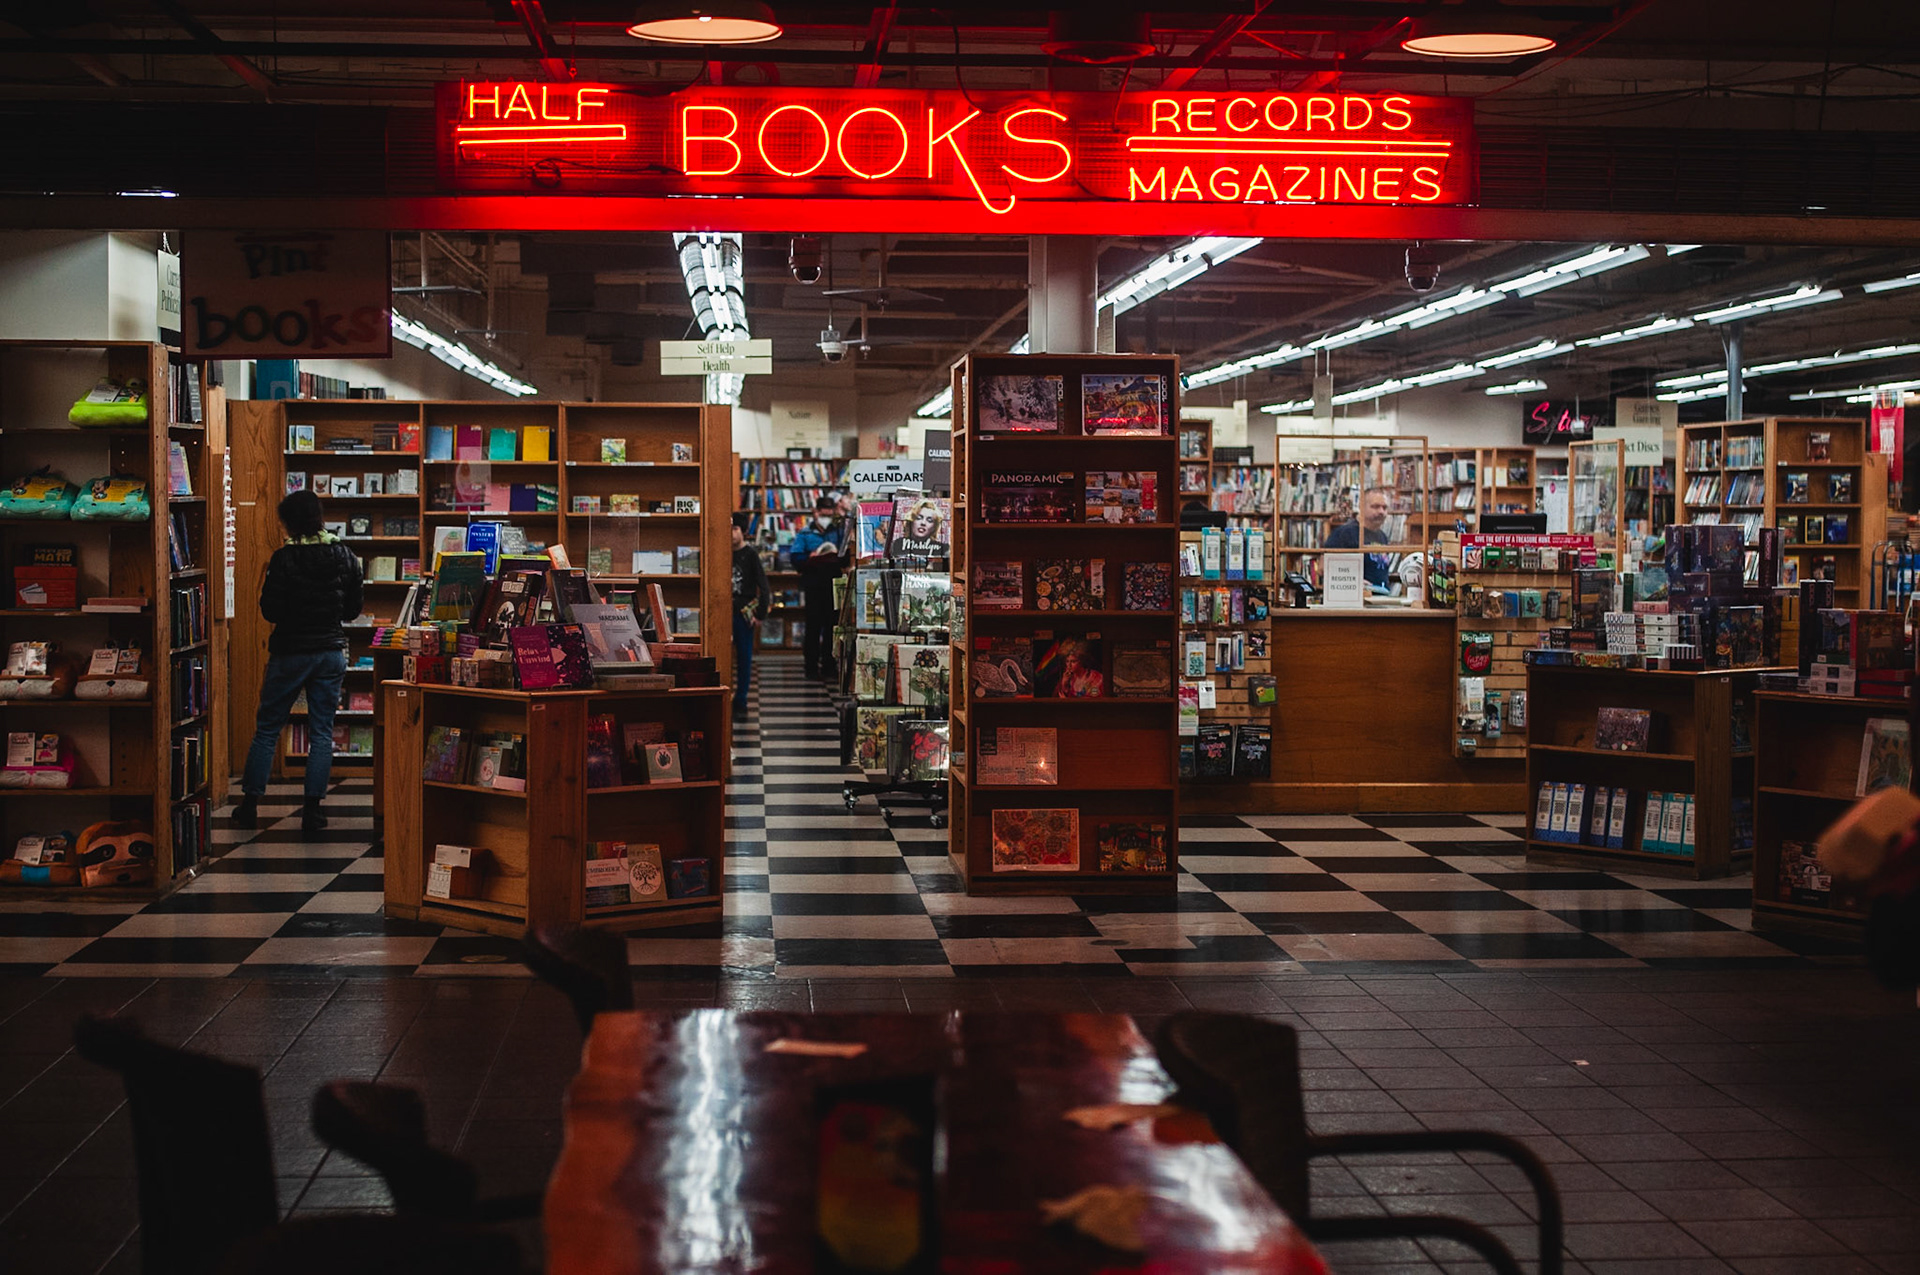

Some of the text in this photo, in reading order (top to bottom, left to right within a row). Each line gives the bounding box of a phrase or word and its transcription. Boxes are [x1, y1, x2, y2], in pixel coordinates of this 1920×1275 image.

[469, 83, 610, 121] HALF
[1152, 96, 1412, 133] RECORDS
[683, 104, 1072, 215] BOOKS
[1129, 164, 1442, 202] MAGAZINES
[191, 296, 386, 350] books
[698, 342, 736, 356] Self Help
[703, 360, 731, 372] Health
[1637, 441, 1660, 452] Discs
[991, 474, 1064, 485] PANORAMIC
[677, 500, 693, 508] BIG
[902, 537, 942, 557] Marilyn
[1474, 535, 1485, 545] GIVE
[1486, 535, 1494, 545] THE
[1495, 535, 1505, 545] GIFT
[1505, 535, 1511, 544] OF
[1511, 535, 1516, 544] A
[1516, 535, 1538, 544] TREASURE
